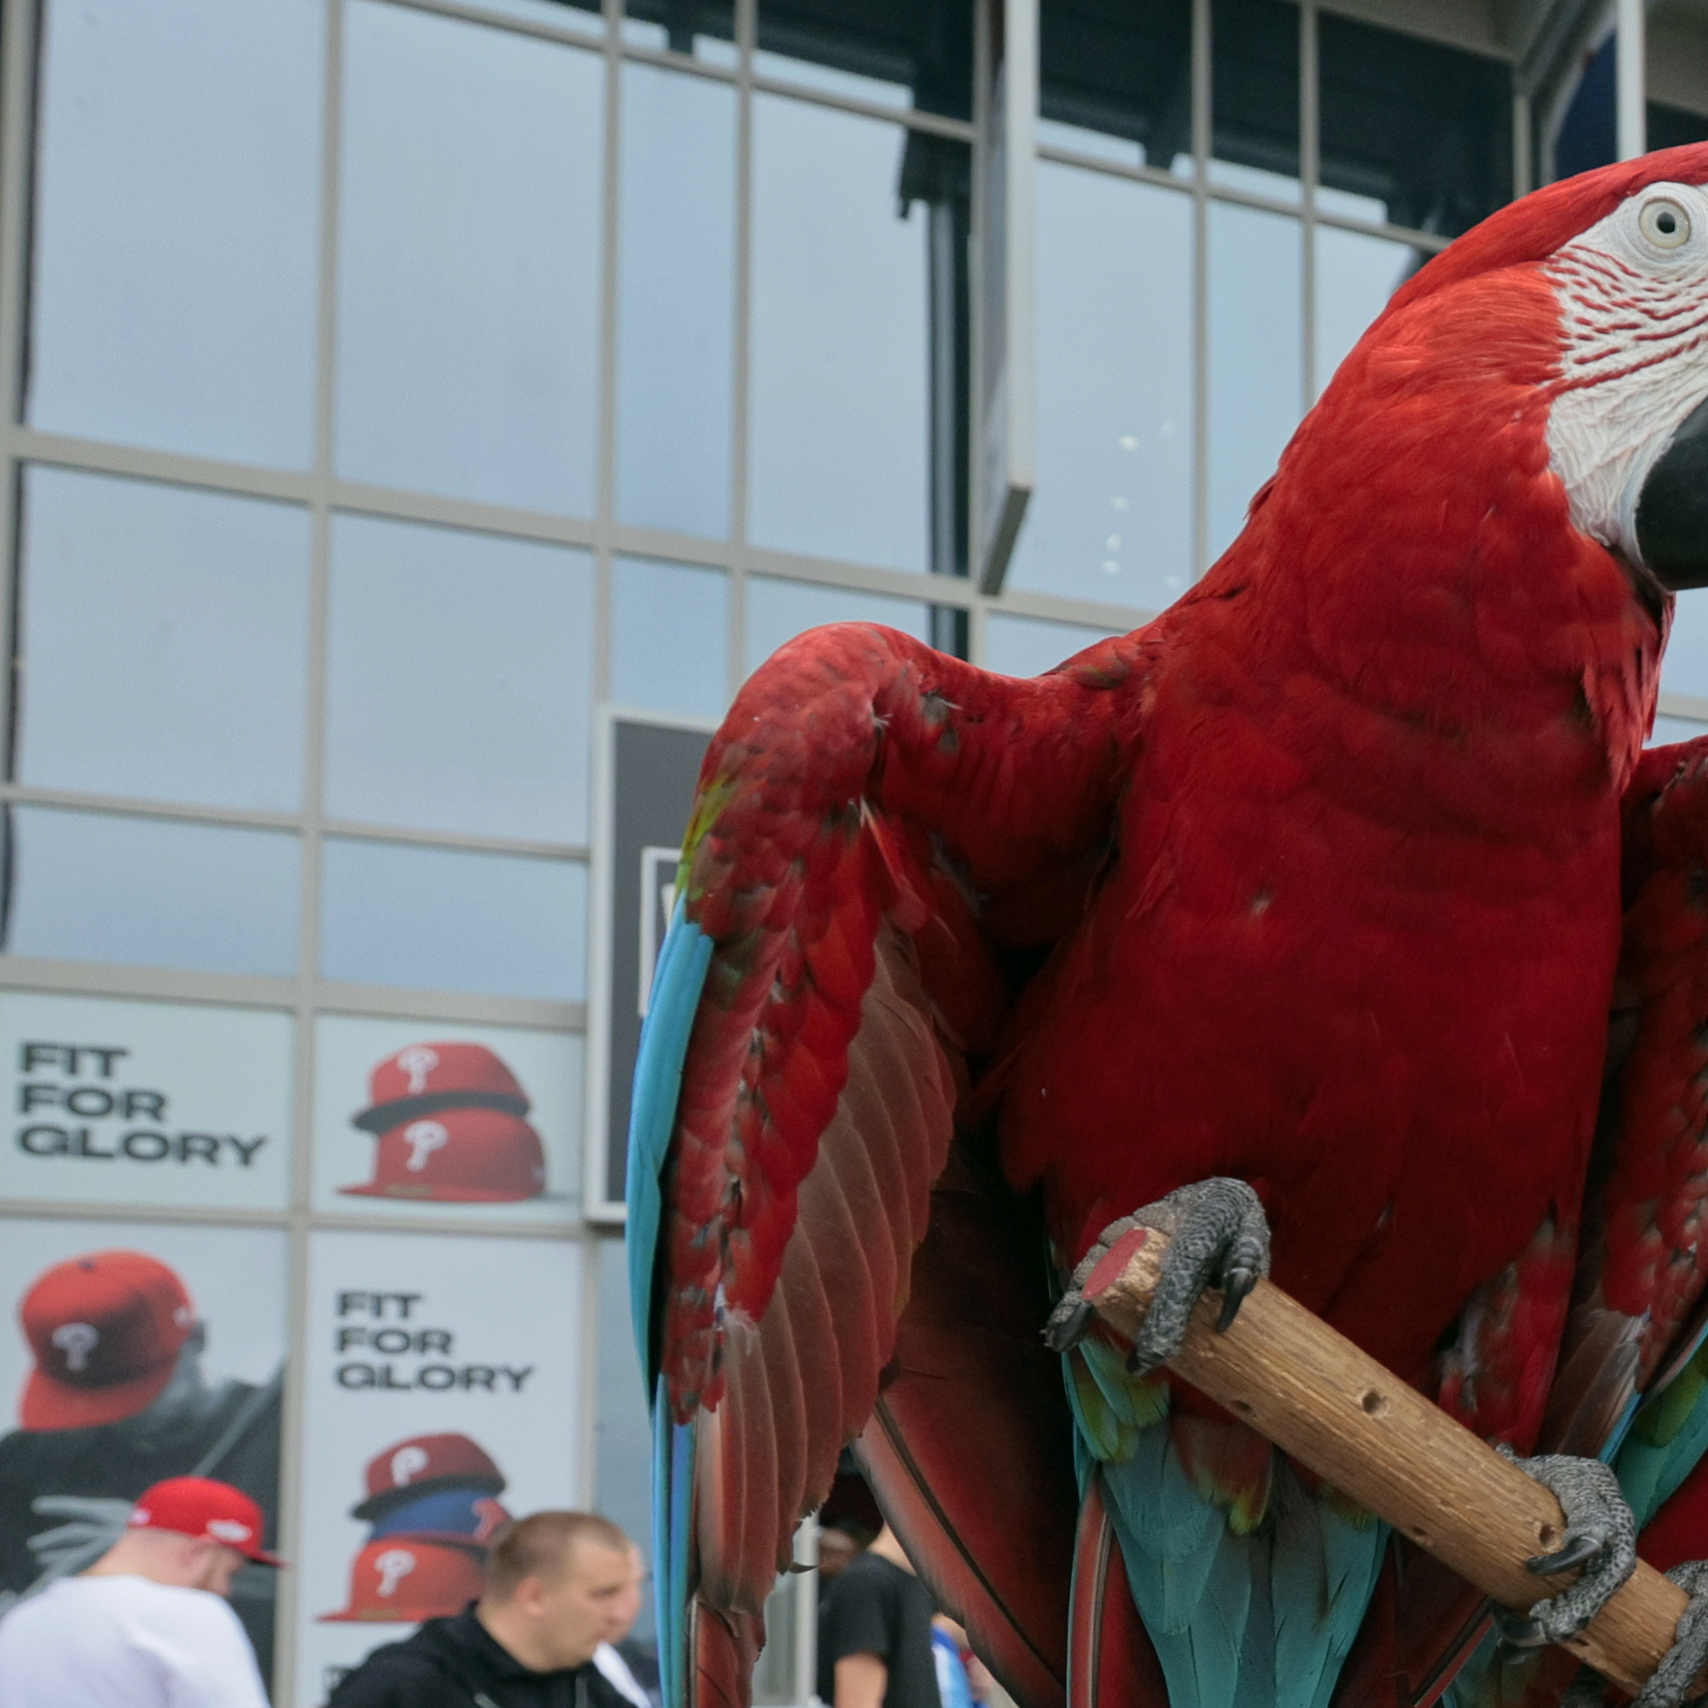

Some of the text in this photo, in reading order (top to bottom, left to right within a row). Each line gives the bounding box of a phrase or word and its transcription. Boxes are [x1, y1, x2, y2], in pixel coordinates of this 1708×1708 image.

[21, 1040, 130, 1078] FIT
[19, 1082, 167, 1123] FOR
[19, 1125, 269, 1168] GLORY
[338, 1289, 423, 1320] FIT
[338, 1325, 454, 1356] FOR
[337, 1362, 534, 1392] GLORY
